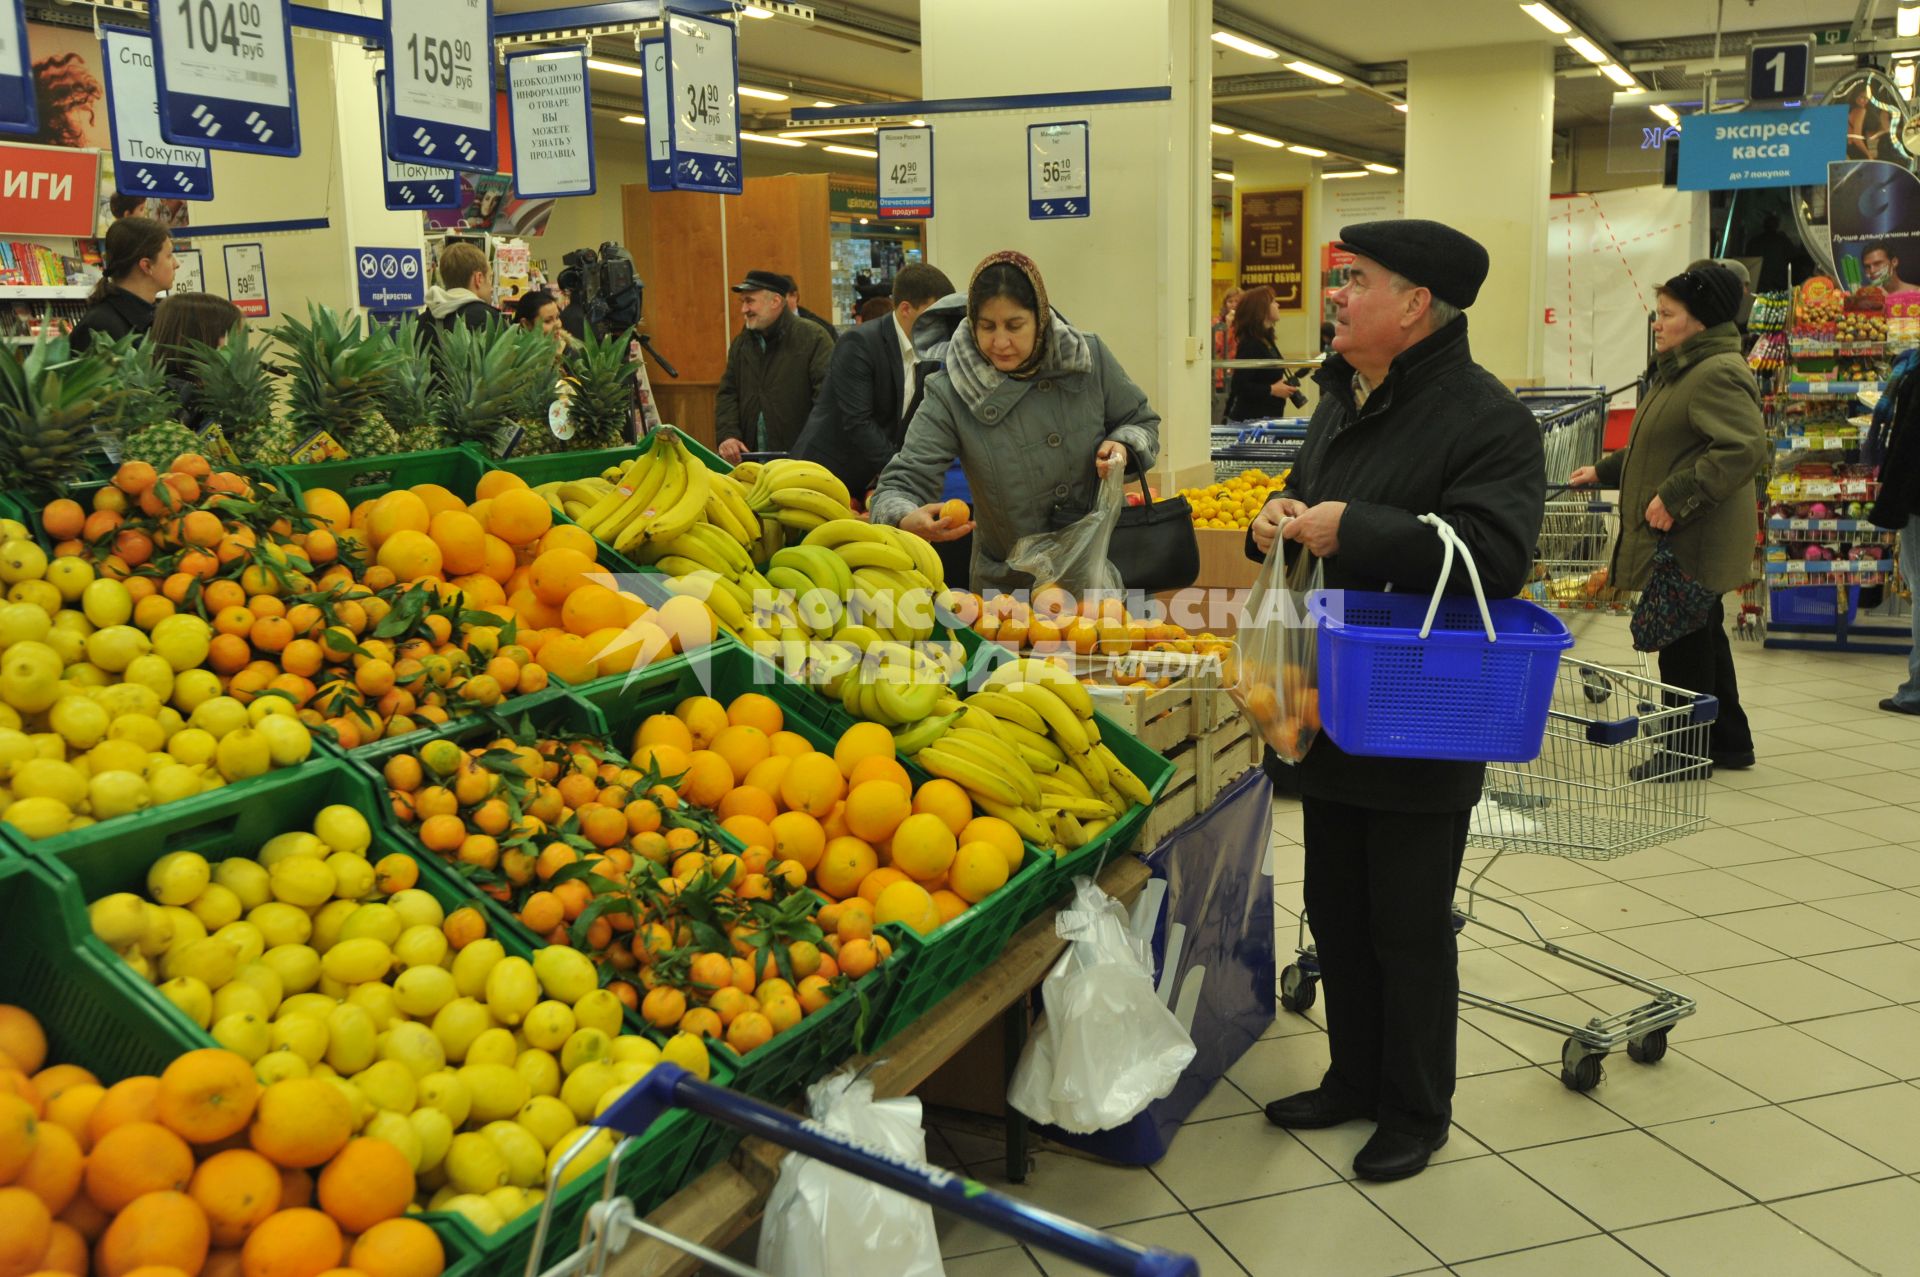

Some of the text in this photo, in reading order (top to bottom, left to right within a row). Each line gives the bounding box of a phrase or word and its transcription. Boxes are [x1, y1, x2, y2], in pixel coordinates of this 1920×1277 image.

[178, 0, 240, 56] 104
[241, 42, 264, 61] руб
[407, 33, 472, 86] 159 90
[537, 63, 558, 74] ВСЮ
[1765, 51, 1786, 93] 1
[456, 74, 473, 90] руб
[513, 72, 582, 88] НЕОБХОДИМУЮ
[516, 85, 581, 100] ИНФОРМАЦИЮ
[528, 98, 570, 110] О ТОВАРЕ
[687, 84, 719, 124] 34 90
[542, 112, 558, 123] ВЫ
[708, 112, 720, 127] руб
[532, 125, 570, 137] МОЖЕТЕ
[1715, 121, 1811, 141] экспресс
[531, 136, 573, 149] УЗНАТЬ У
[128, 139, 201, 167] Покупку
[530, 150, 576, 161] ПРОДАВЦА
[1732, 143, 1790, 160] касса
[890, 162, 917, 184] 42 90
[1043, 158, 1071, 182] 56 10
[1060, 173, 1071, 181] руб
[1729, 169, 1791, 181] до 7 покупок
[3, 169, 73, 202] ИГИ
[892, 207, 919, 216] продукт
[237, 278, 249, 294] 59
[1241, 272, 1302, 284] РЕМОНТ ОБУВИ
